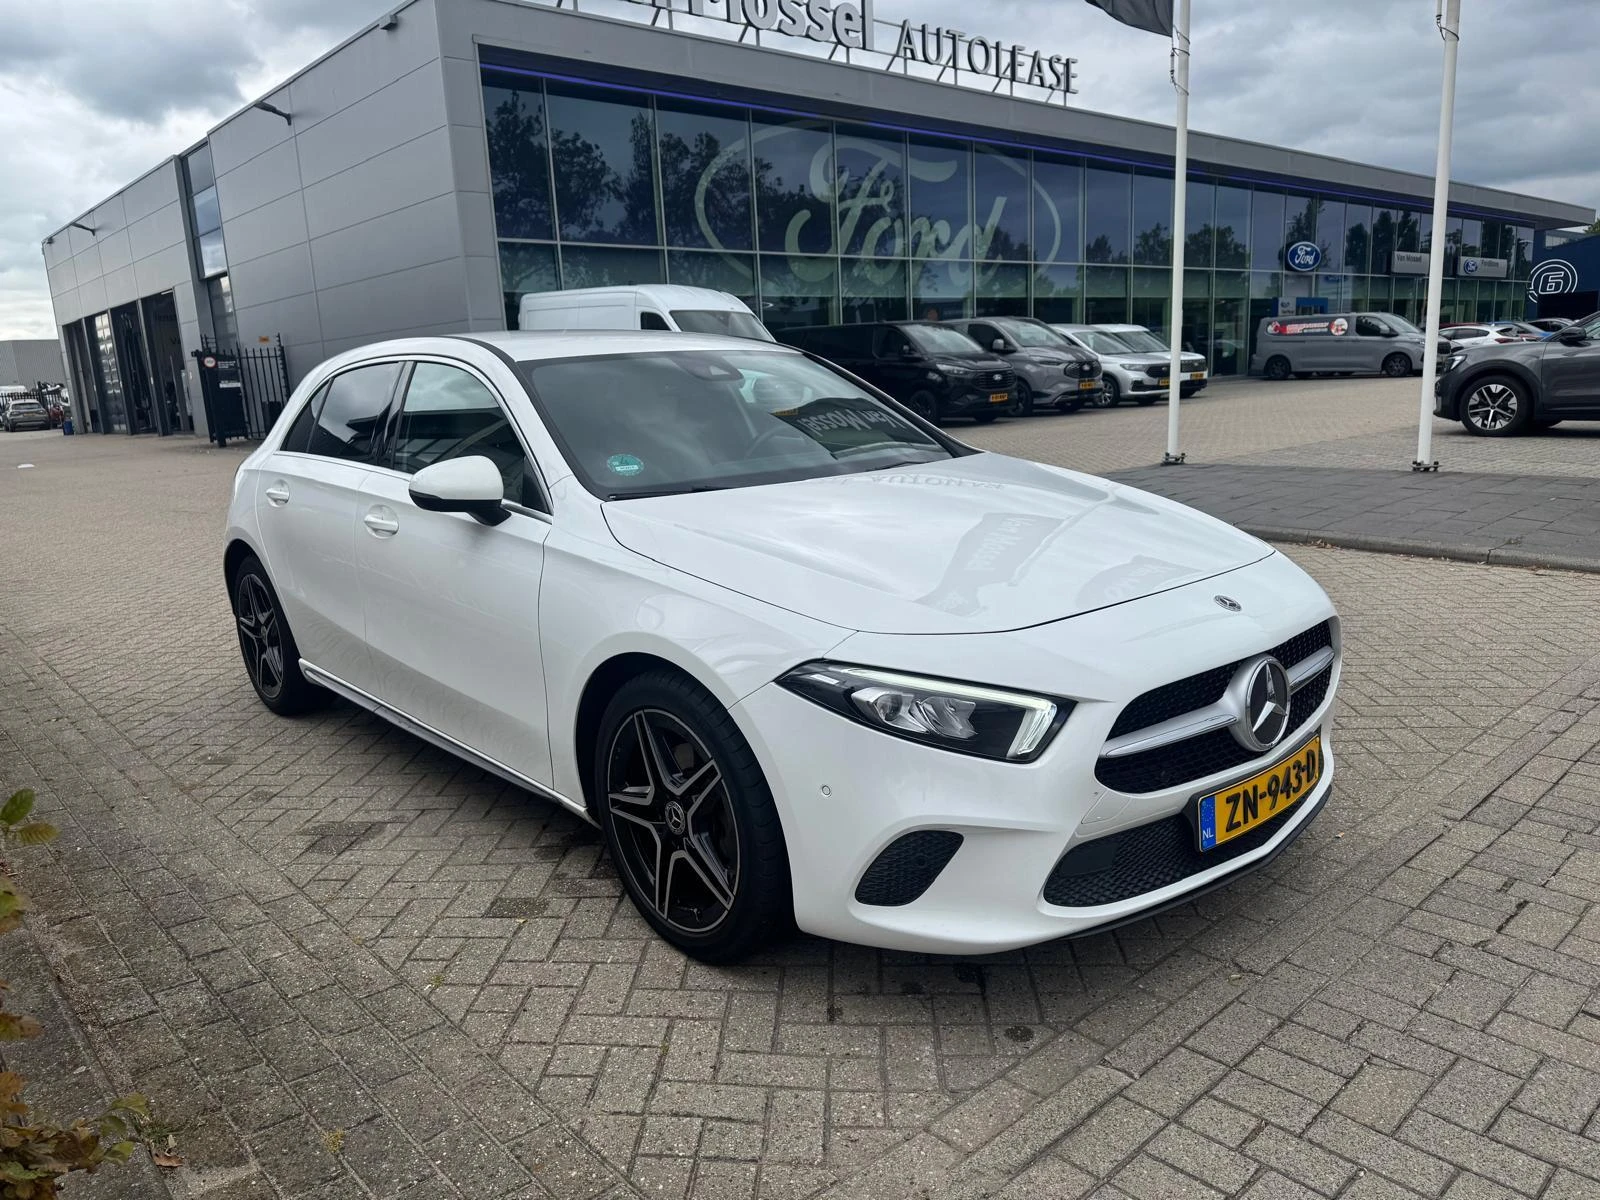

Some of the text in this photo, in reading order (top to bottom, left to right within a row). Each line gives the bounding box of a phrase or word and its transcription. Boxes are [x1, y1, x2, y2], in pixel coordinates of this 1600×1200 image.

[896, 19, 1079, 94] AUTOLEASE
[784, 138, 1008, 286] Ford
[1294, 245, 1316, 265] Ford
[1202, 749, 1317, 840] NL ZN-943-D
